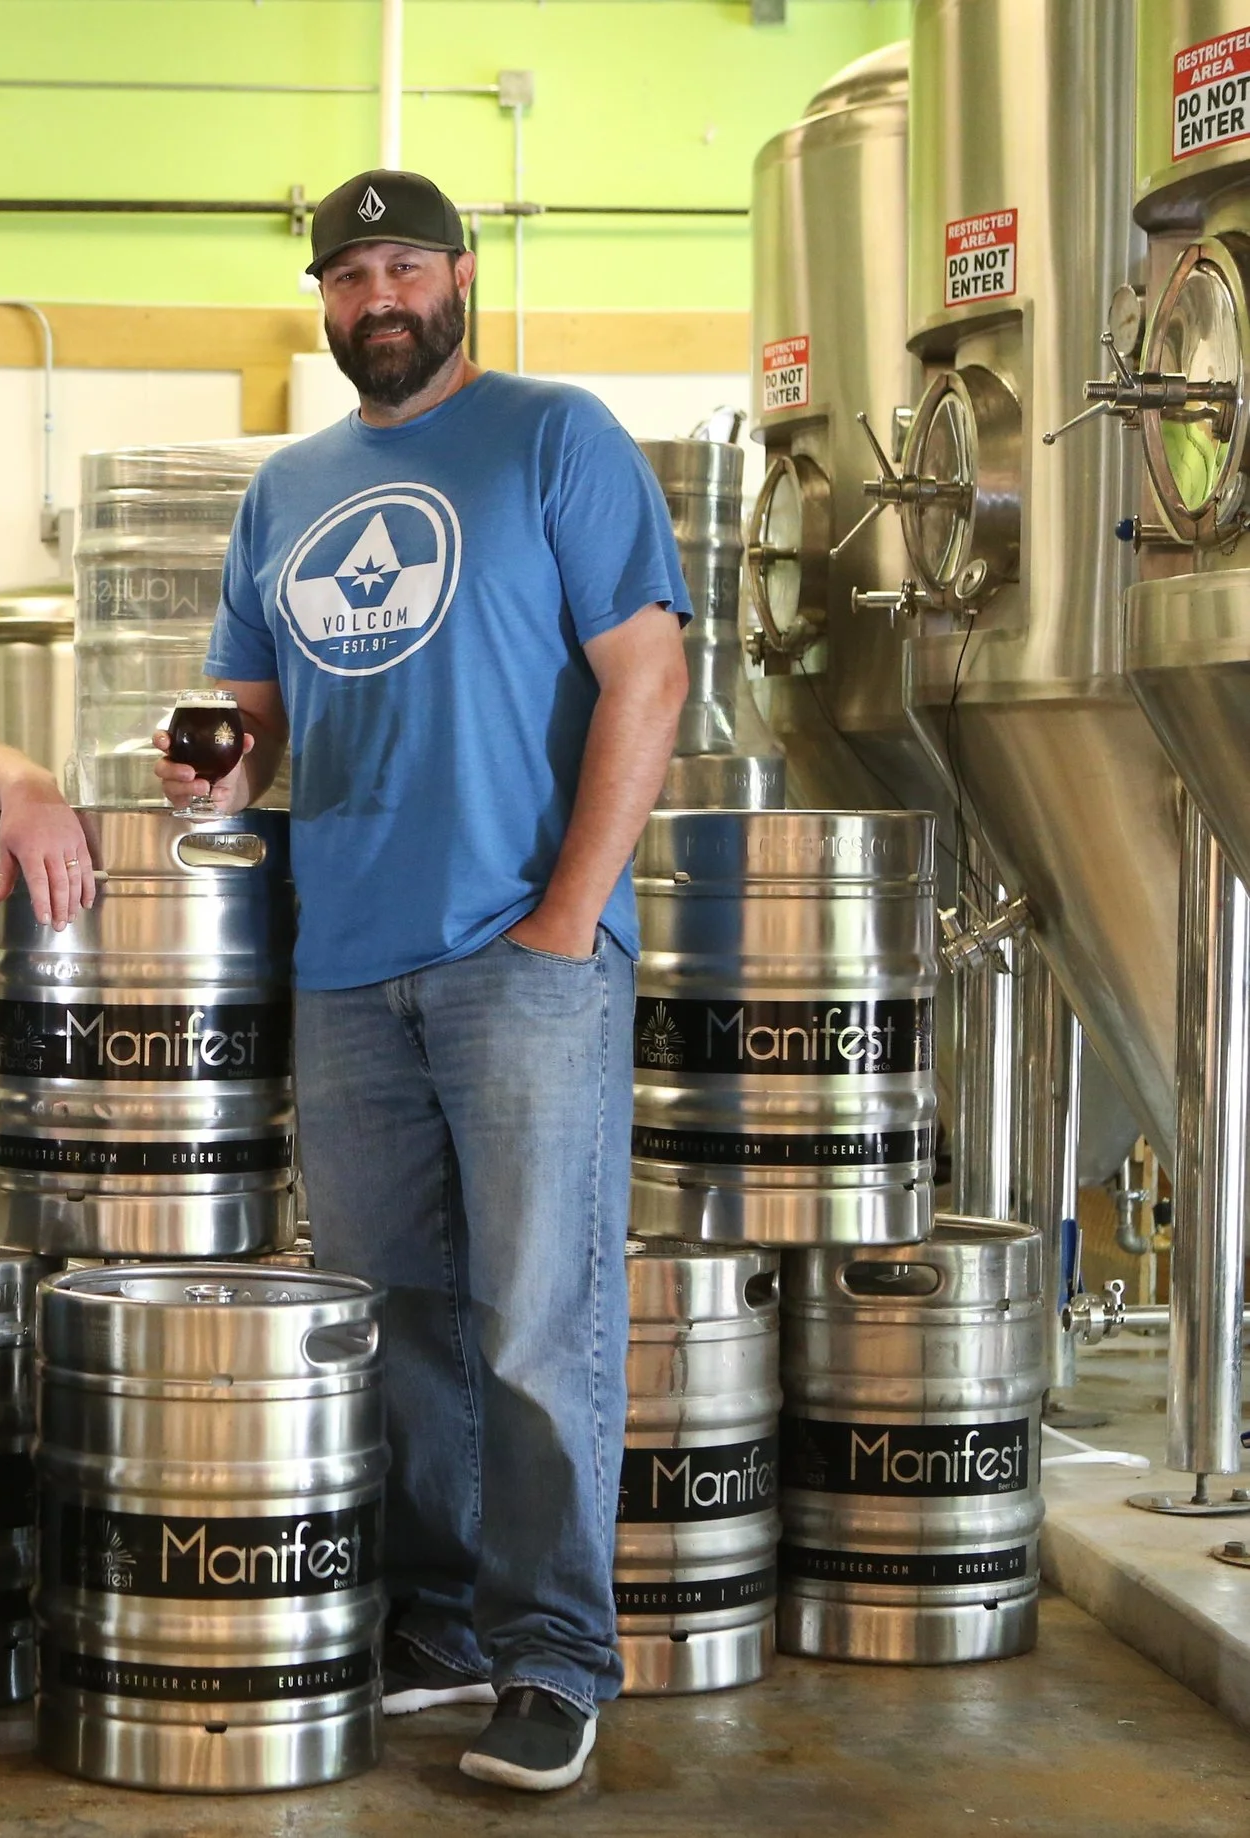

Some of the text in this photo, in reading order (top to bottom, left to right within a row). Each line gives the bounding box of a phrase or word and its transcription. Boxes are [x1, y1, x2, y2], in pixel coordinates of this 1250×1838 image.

[1191, 57, 1235, 85] AREA
[1178, 76, 1250, 122] DO NOT
[1181, 106, 1245, 149] ENTER
[948, 212, 1013, 239] RESTRICTED
[960, 231, 996, 250] AREA
[949, 248, 1009, 278] DO NOT
[952, 272, 1004, 299] ENTER
[766, 367, 803, 389] DO NOT
[767, 386, 800, 406] ENTER
[323, 606, 408, 635] VOLCOM
[65, 1008, 260, 1067] Manifest
[706, 1006, 896, 1061] Manifest
[850, 1428, 1023, 1484] Manifest
[652, 1445, 777, 1509] Manifes
[998, 1481, 1011, 1491] Beer
[1009, 1559, 1020, 1570] OR
